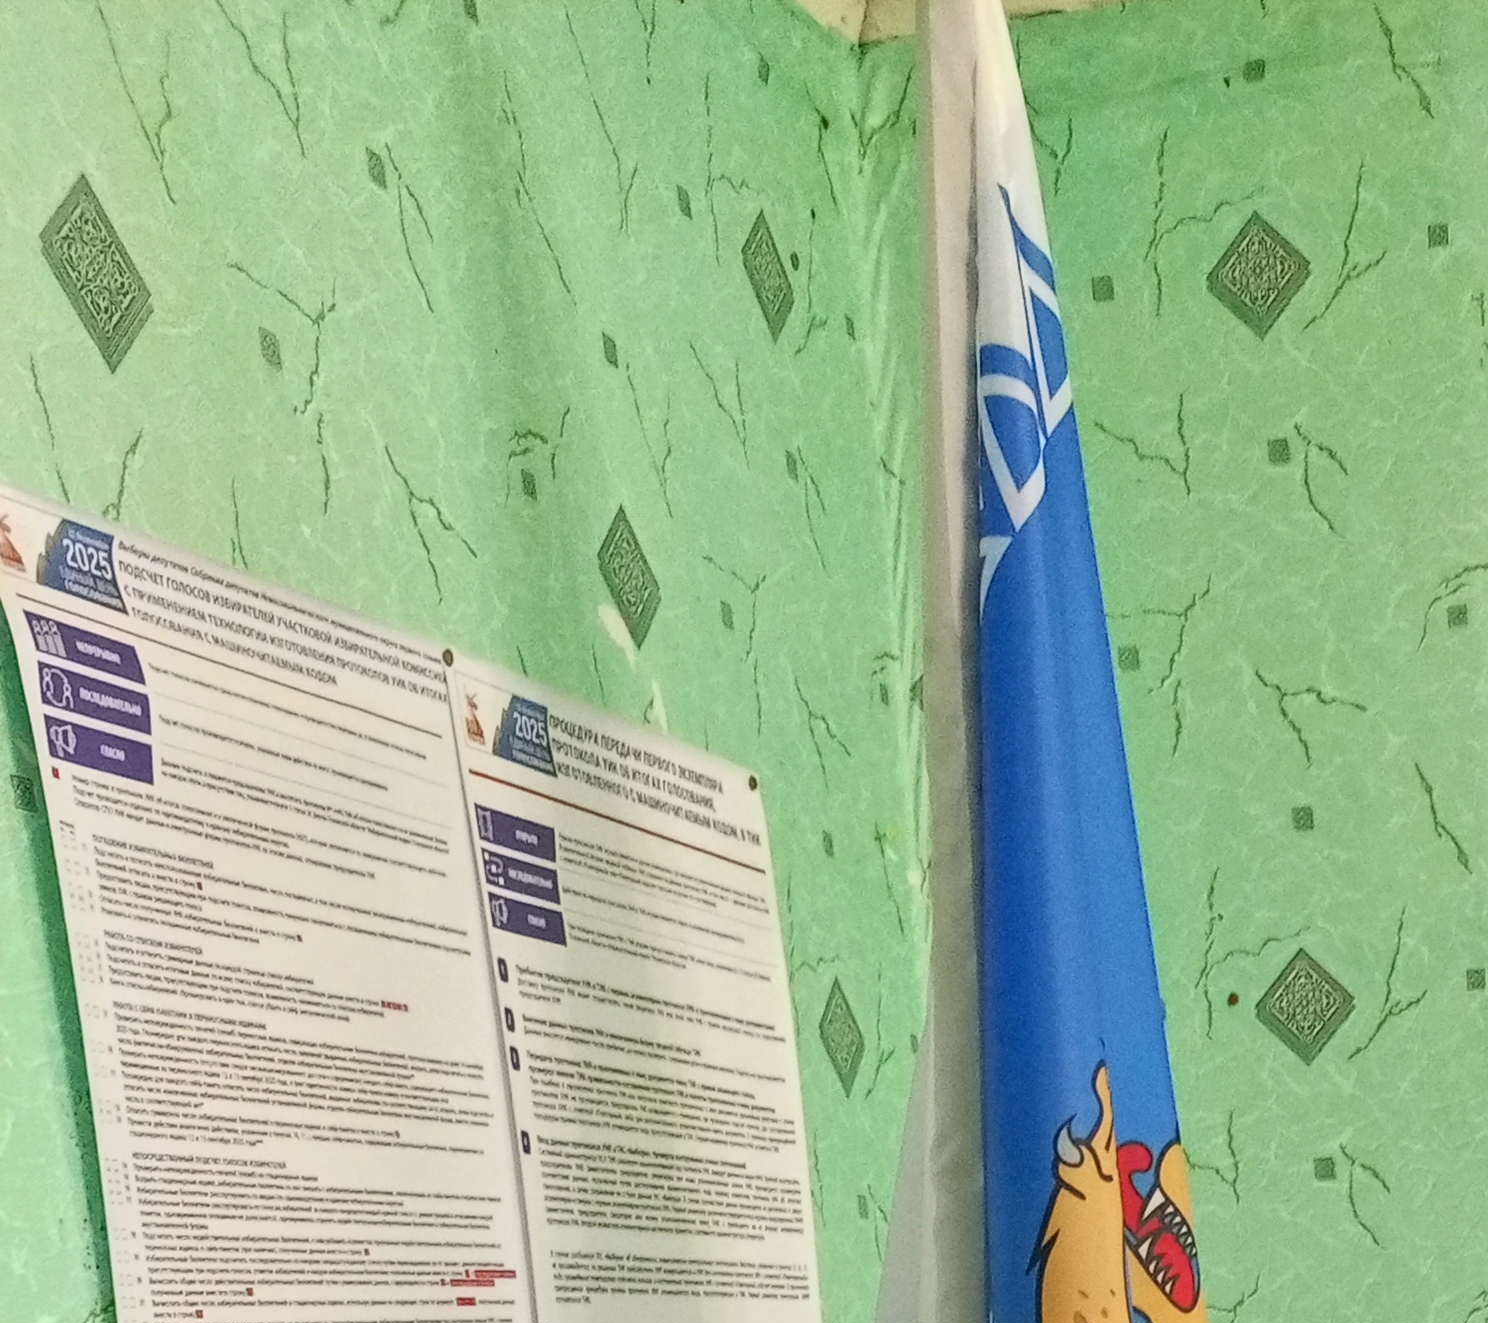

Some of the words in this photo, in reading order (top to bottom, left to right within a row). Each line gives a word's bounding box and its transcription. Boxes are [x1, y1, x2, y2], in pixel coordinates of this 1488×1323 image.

[62, 538, 112, 580] 2025
[166, 577, 211, 604] ГОЛОСОВ
[513, 711, 548, 747] 2025
[549, 714, 600, 747] ПРОЦЕДУРА
[600, 730, 643, 761] ПЕРЕДАЧИ
